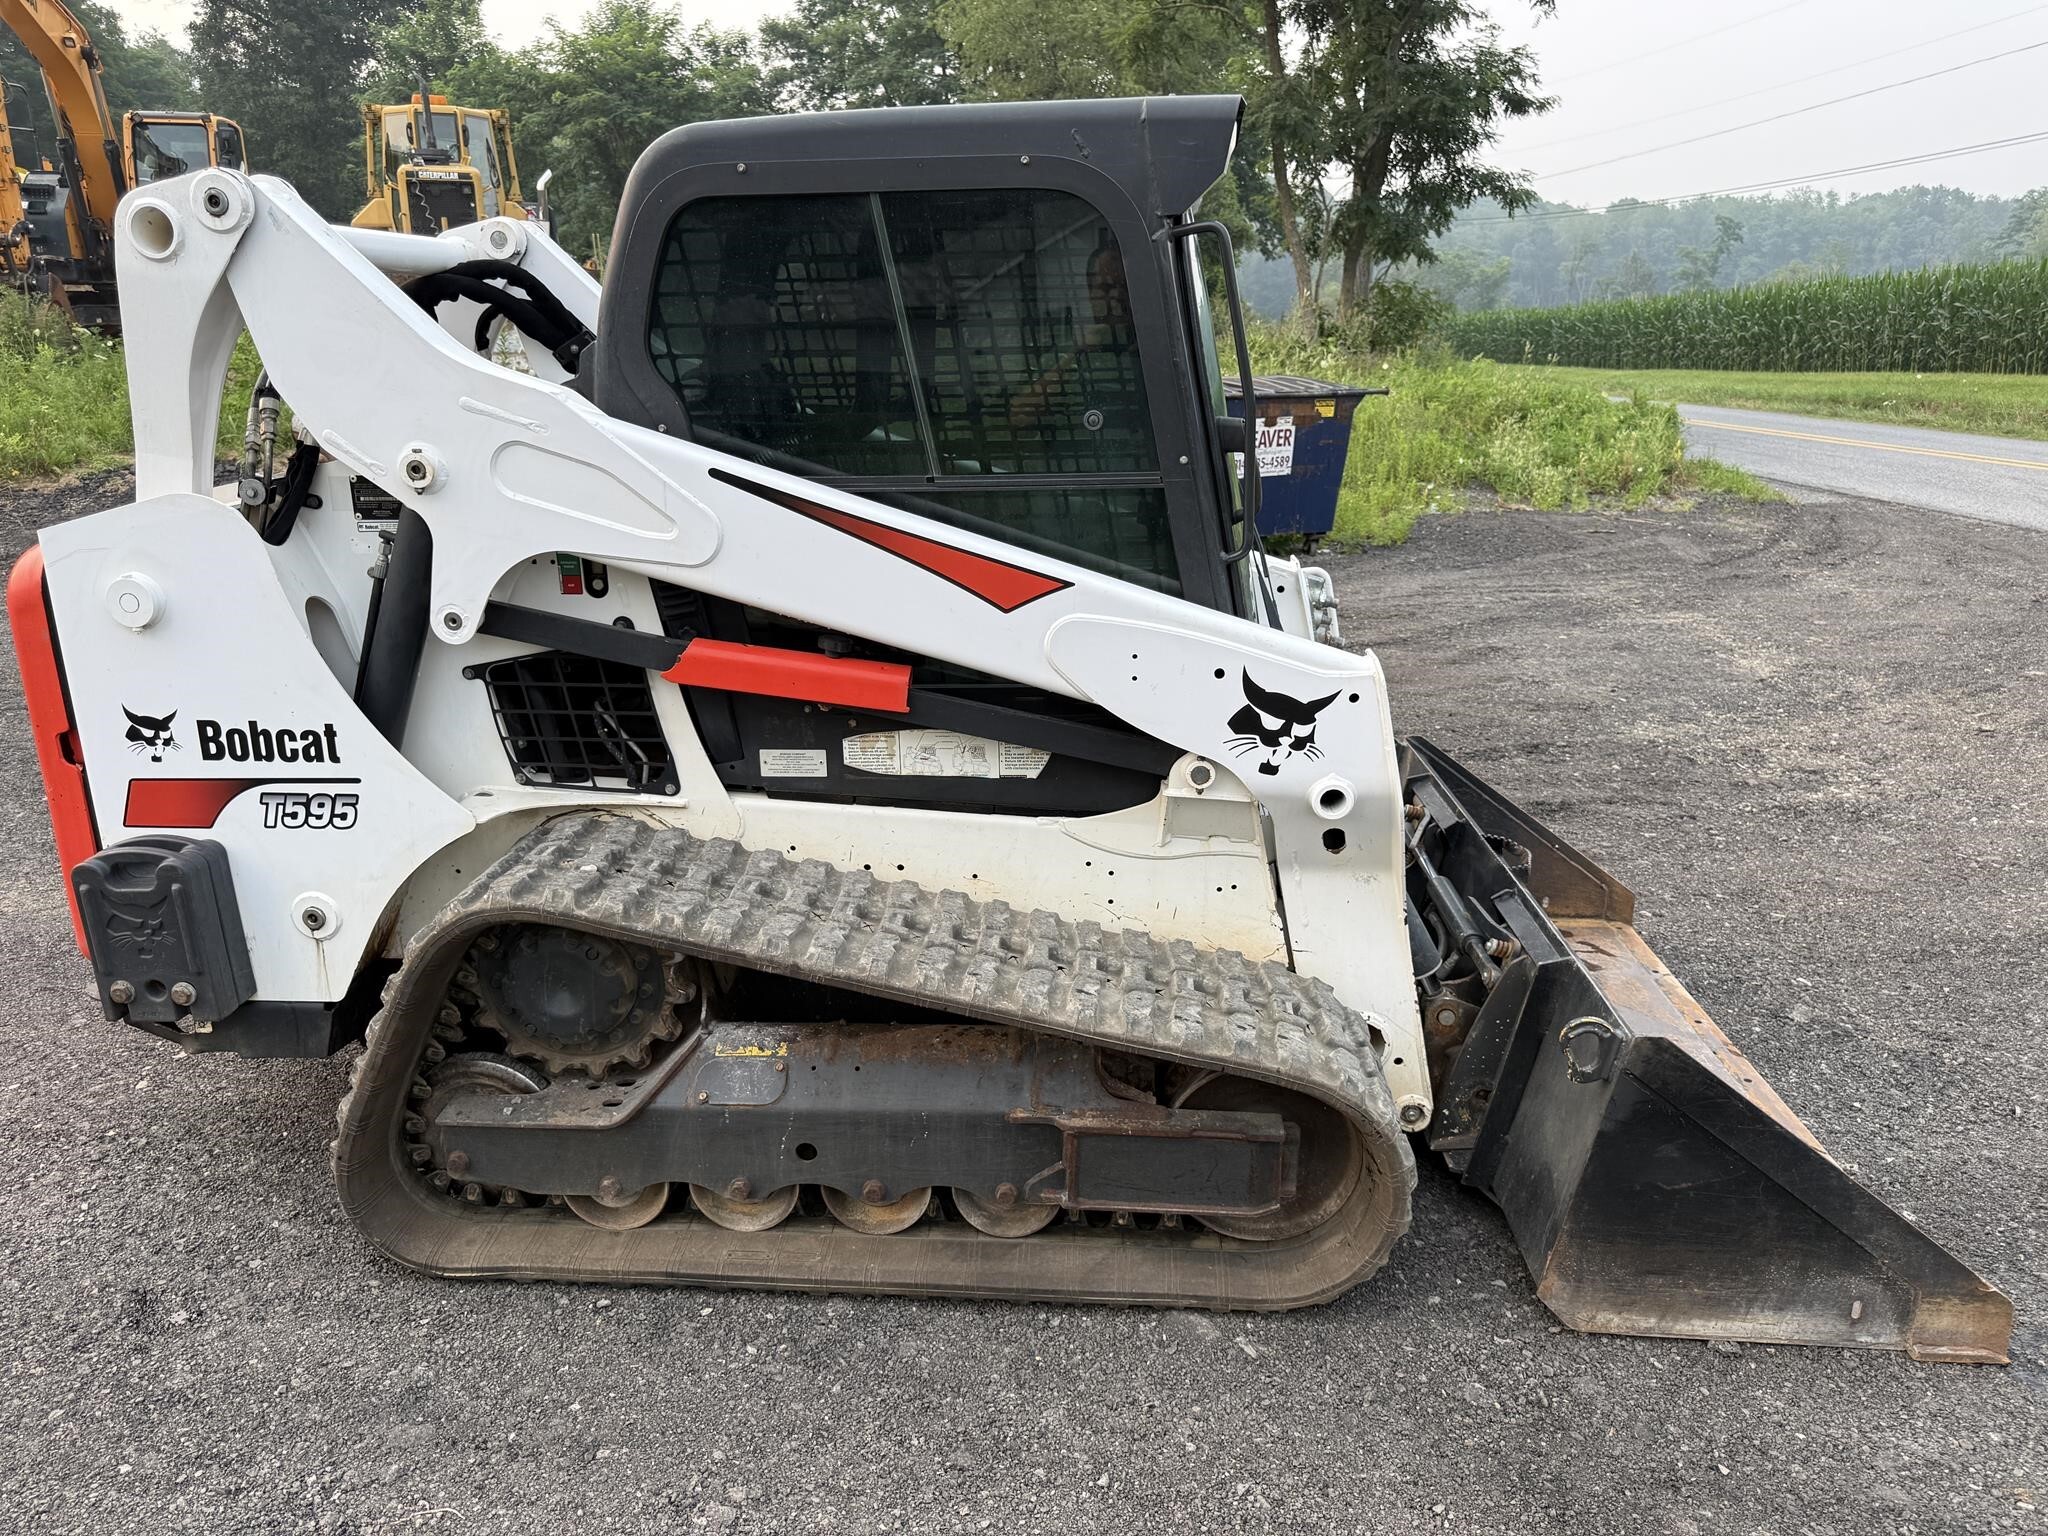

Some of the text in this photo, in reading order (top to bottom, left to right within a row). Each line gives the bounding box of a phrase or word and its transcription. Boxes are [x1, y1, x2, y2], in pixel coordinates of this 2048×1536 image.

[418, 171, 459, 179] CATERPILLAR
[196, 719, 341, 763] Bobcat
[260, 792, 359, 829] T595
